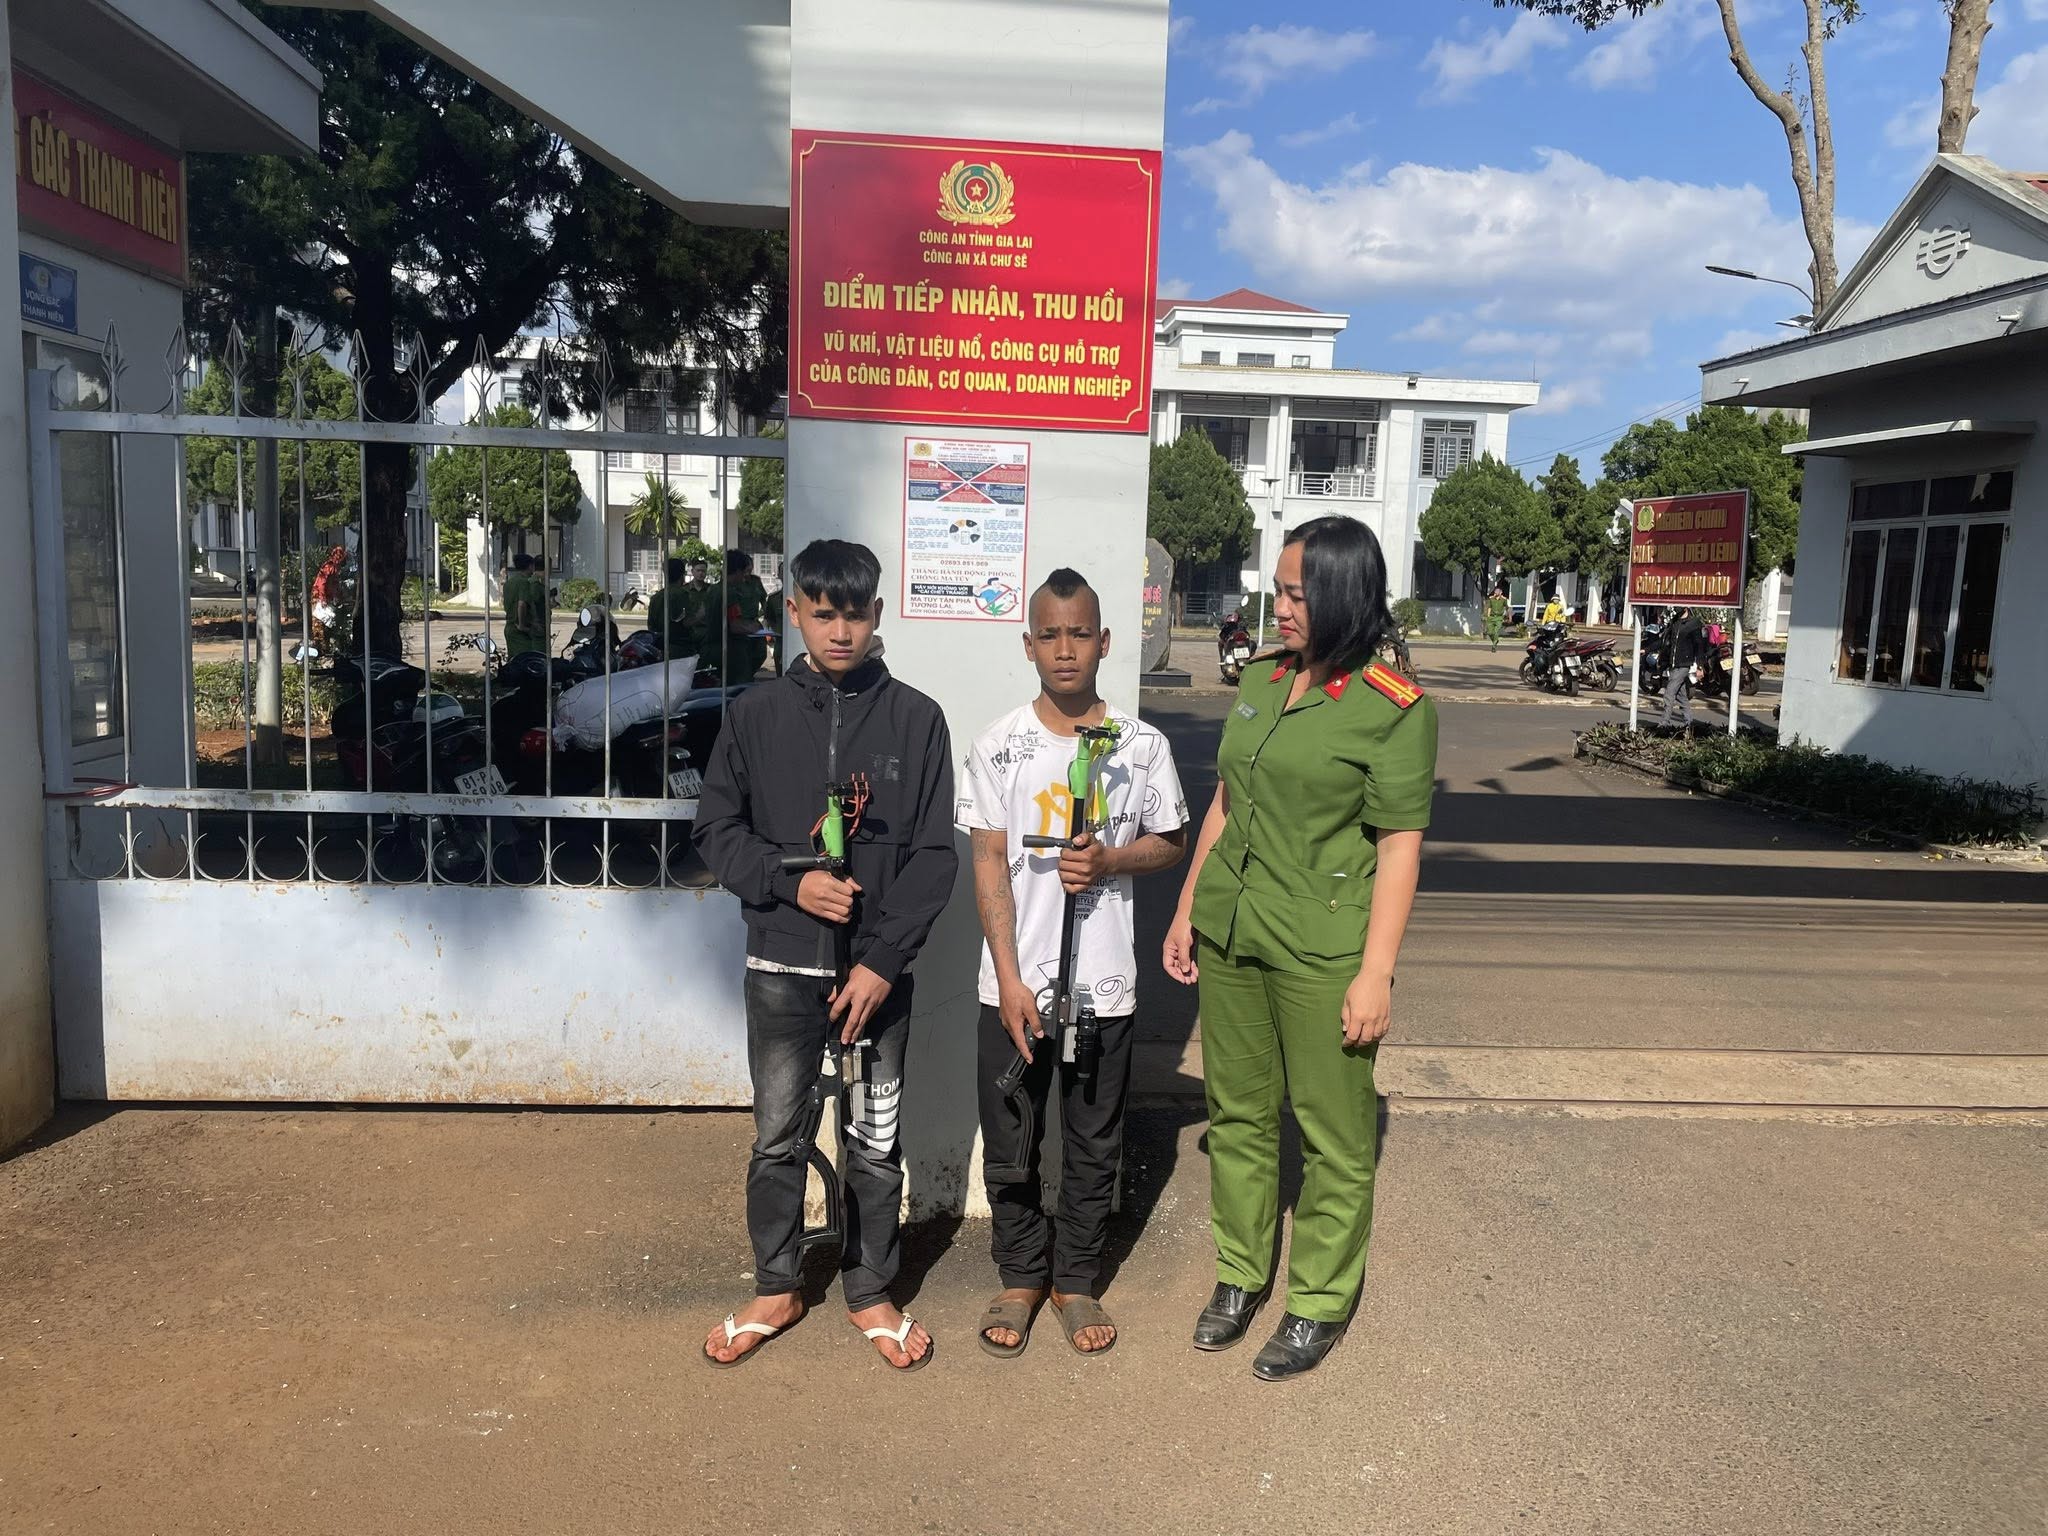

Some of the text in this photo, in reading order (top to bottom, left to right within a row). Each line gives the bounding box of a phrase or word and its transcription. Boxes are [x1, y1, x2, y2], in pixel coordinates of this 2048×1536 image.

[30, 110, 70, 197] GÁC
[77, 140, 135, 225] THANH
[141, 169, 177, 244] NIÊN
[919, 229, 1033, 248] CÔNG AN TỈNH GIA LAI
[923, 249, 952, 263] CÔNG
[955, 252, 970, 265] AN
[990, 254, 1013, 267] CHƯ
[1014, 253, 1027, 268] SÊ
[823, 272, 1124, 323] ĐIỂM TIẾP NHẬN, THU HỒI
[824, 329, 1121, 370] VŨ KHÍ, VẬT LIỆU NỔ, CÔNG CỤ HỖ TRỢ
[809, 358, 1132, 401] CỦA CÔNG DÂN, CƠ QUAN, DOANH NGHIỆP
[1635, 572, 1661, 595] CÔNG
[1677, 572, 1706, 595] NHÂN
[1706, 572, 1731, 596] DÂN
